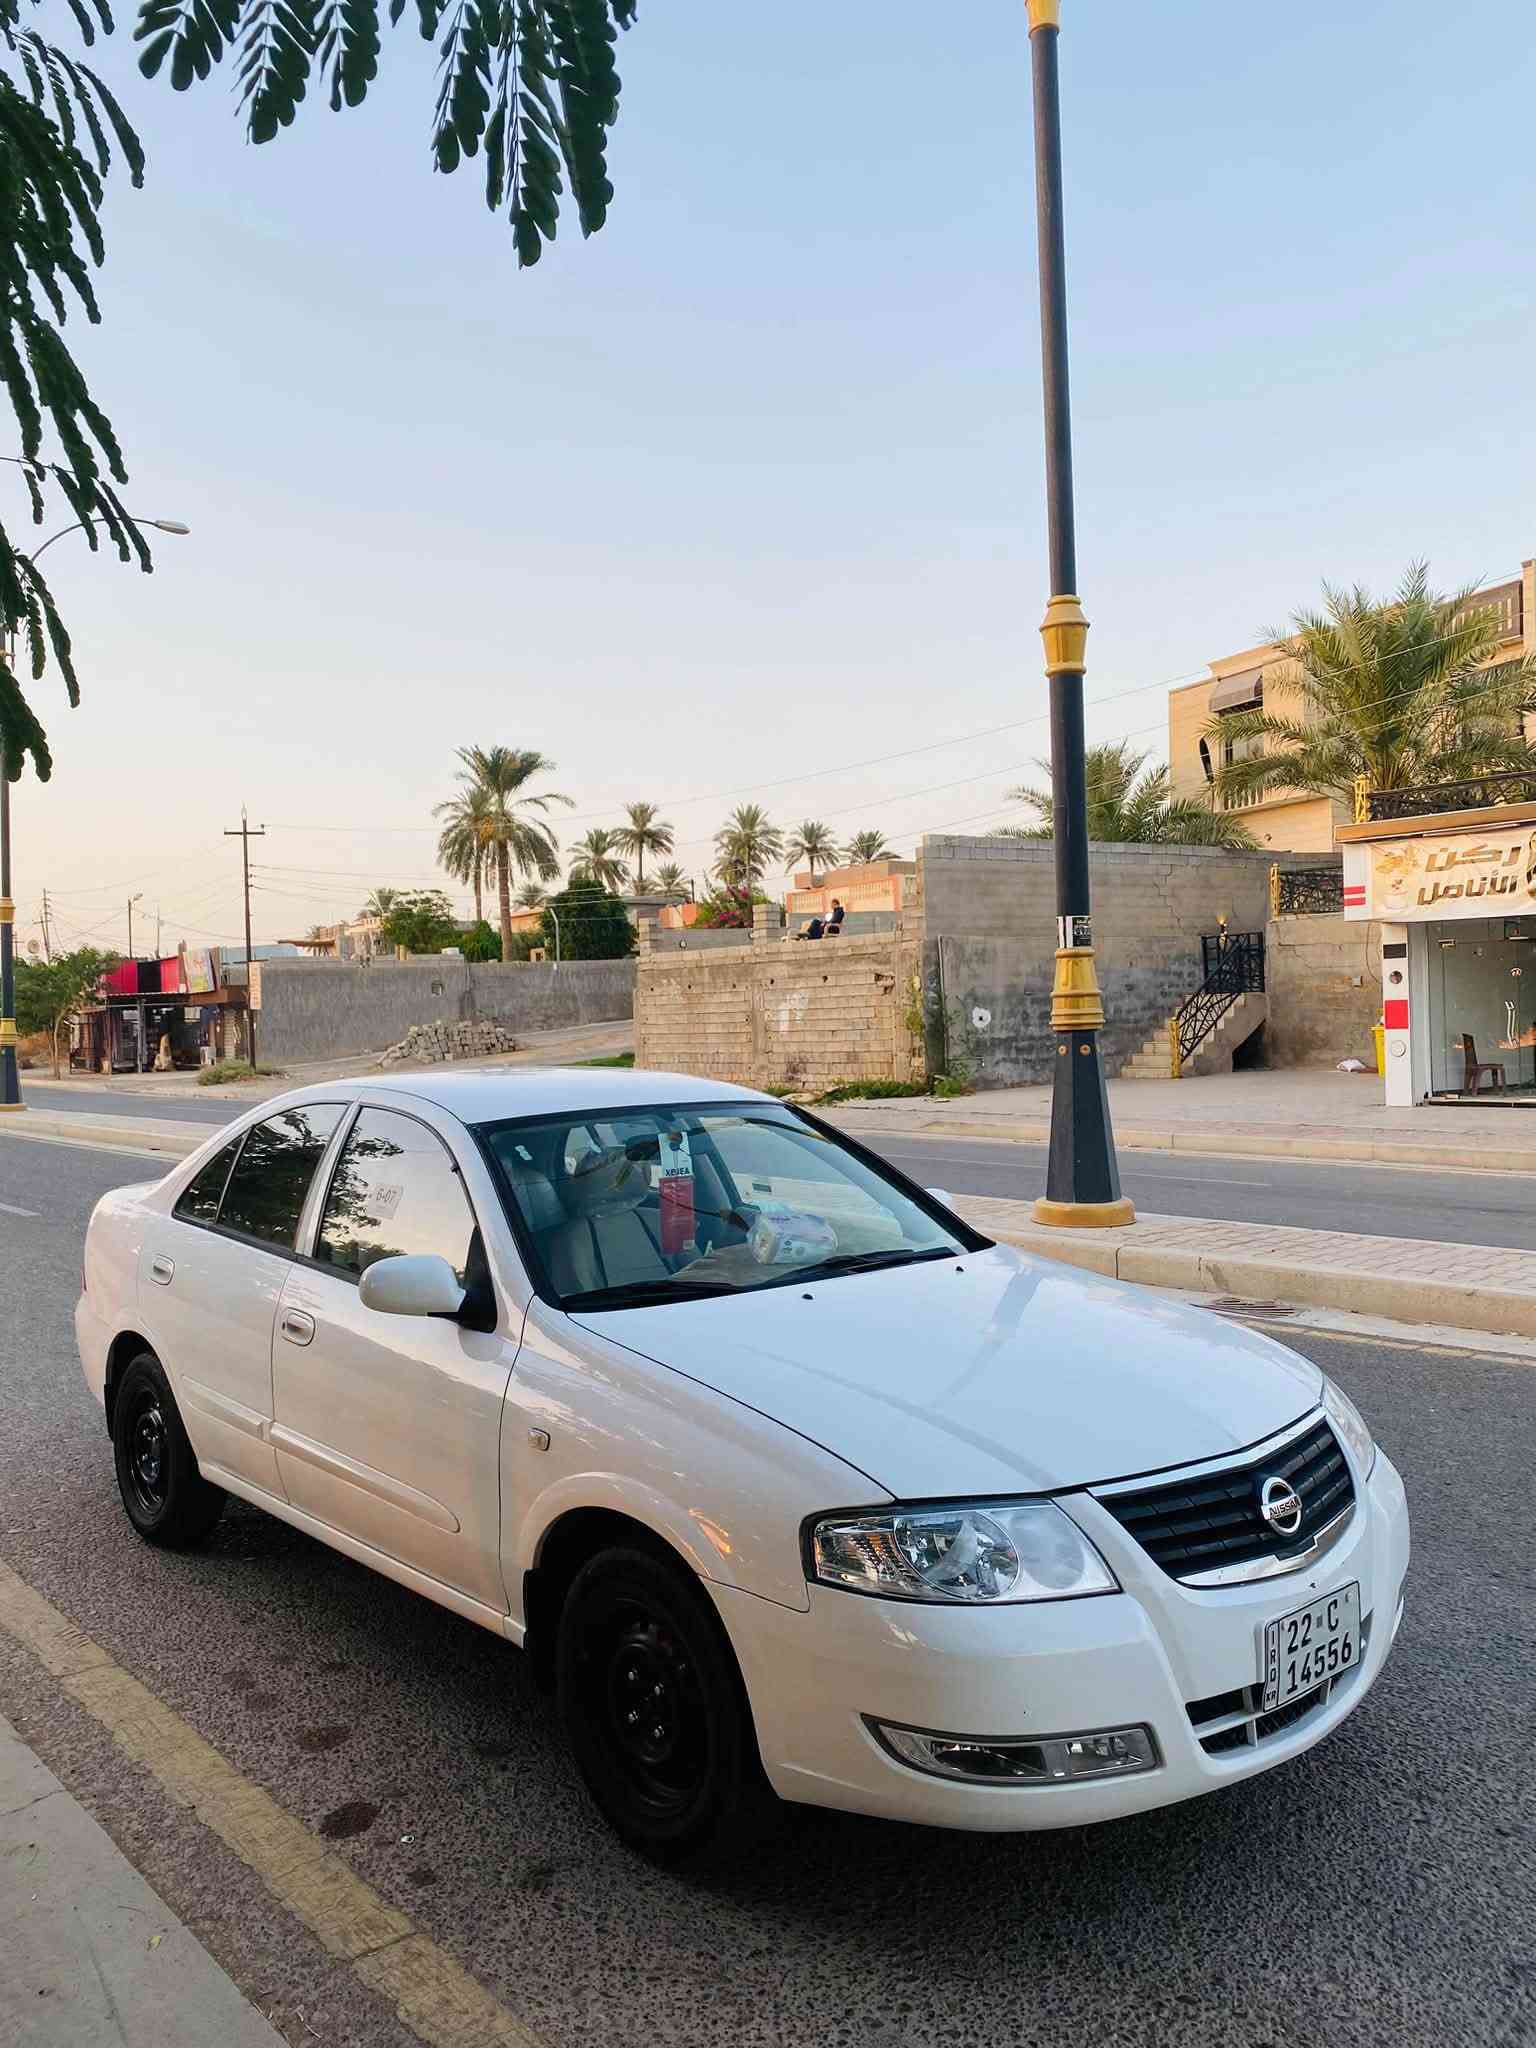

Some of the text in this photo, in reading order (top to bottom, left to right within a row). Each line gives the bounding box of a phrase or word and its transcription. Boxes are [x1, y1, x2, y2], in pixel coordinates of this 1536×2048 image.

[1425, 844, 1522, 872] ركن
[1269, 1495, 1300, 1516] NISSAN
[1287, 1599, 1339, 1655] 22 C
[1286, 1632, 1352, 1695] 14556
